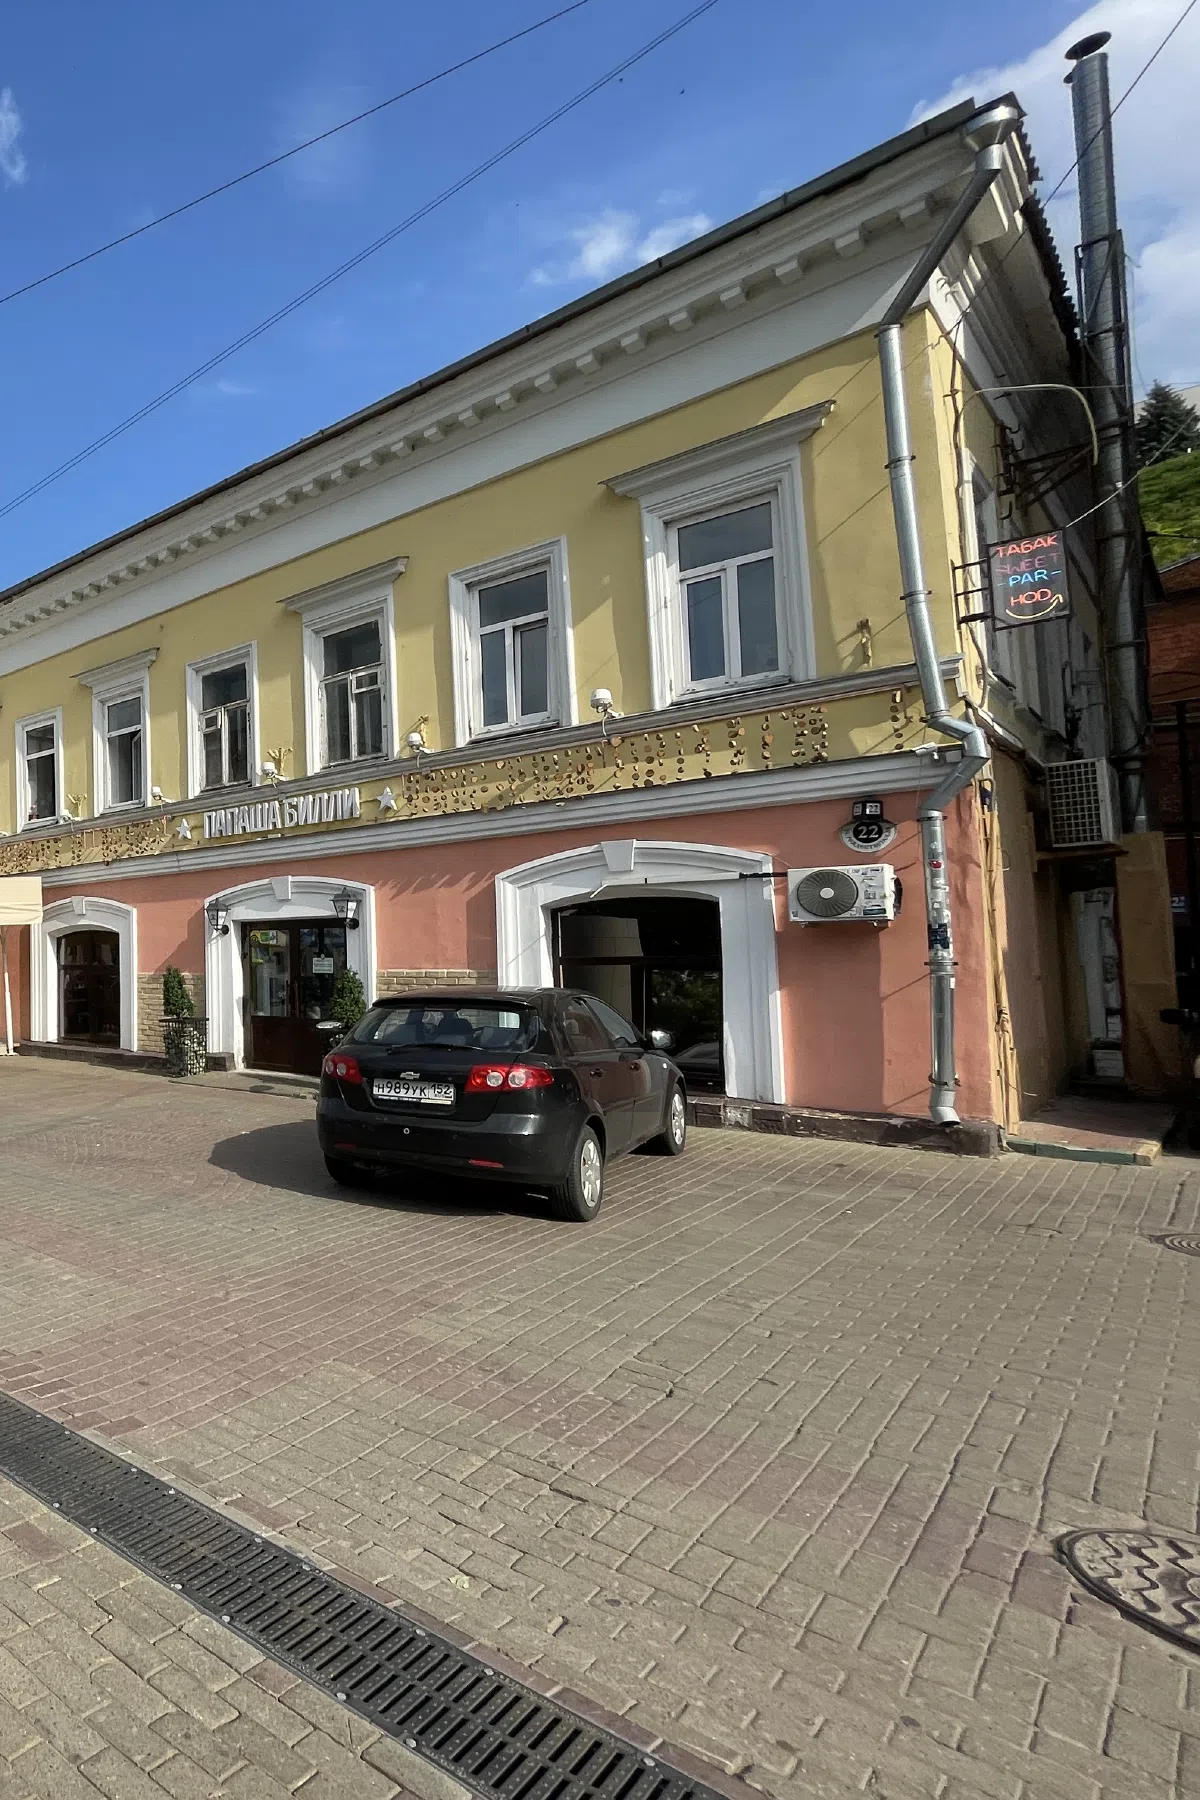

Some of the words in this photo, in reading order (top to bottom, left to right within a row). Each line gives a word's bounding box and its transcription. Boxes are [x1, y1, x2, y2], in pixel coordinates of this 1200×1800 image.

[996, 535, 1058, 558] ТАБАК
[203, 800, 282, 838] ПАПАША
[282, 787, 360, 827] БИЛЛИ
[858, 825, 879, 838] 22
[377, 1081, 427, 1096] Н989УК
[430, 1084, 450, 1095] 152
